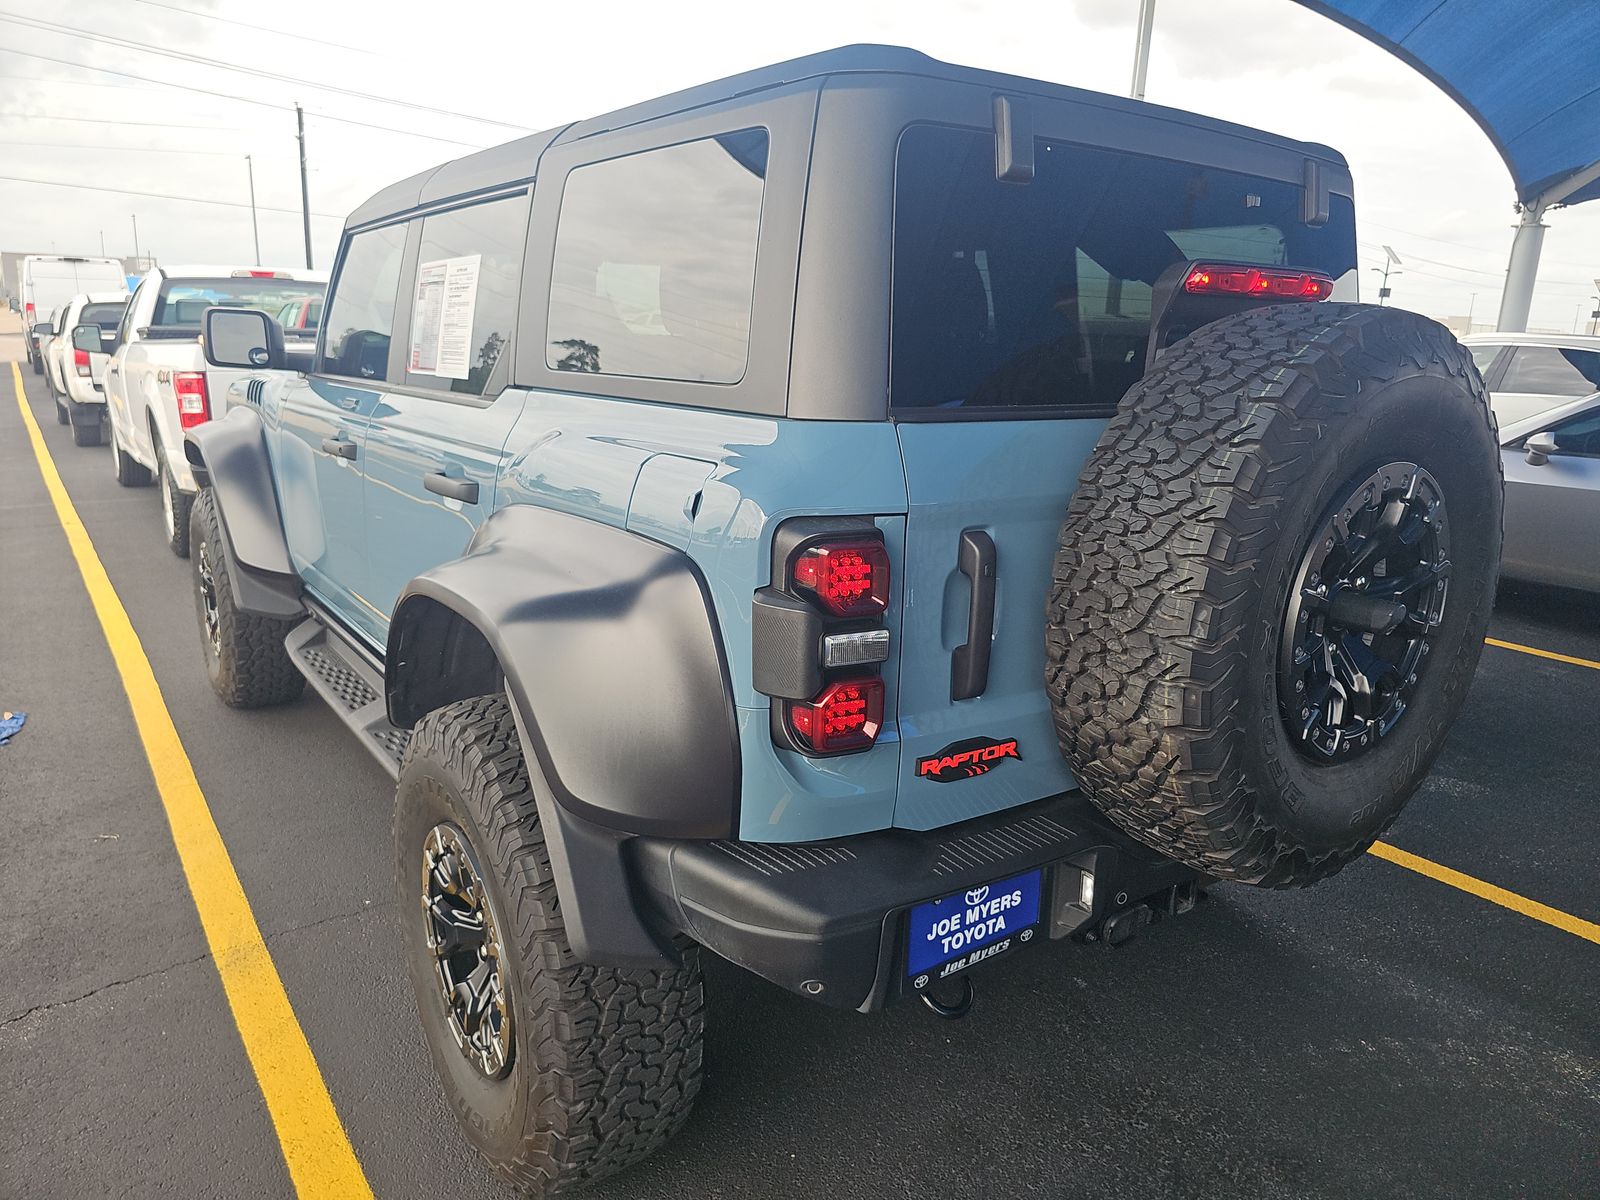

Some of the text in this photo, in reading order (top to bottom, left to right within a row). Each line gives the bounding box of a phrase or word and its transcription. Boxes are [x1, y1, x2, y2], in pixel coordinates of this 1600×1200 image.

[920, 741, 1018, 776] RAPTOR
[927, 890, 1022, 941] JOE MYERS
[941, 915, 1006, 954] TOYOTA
[940, 938, 1011, 976] Joe Myers
